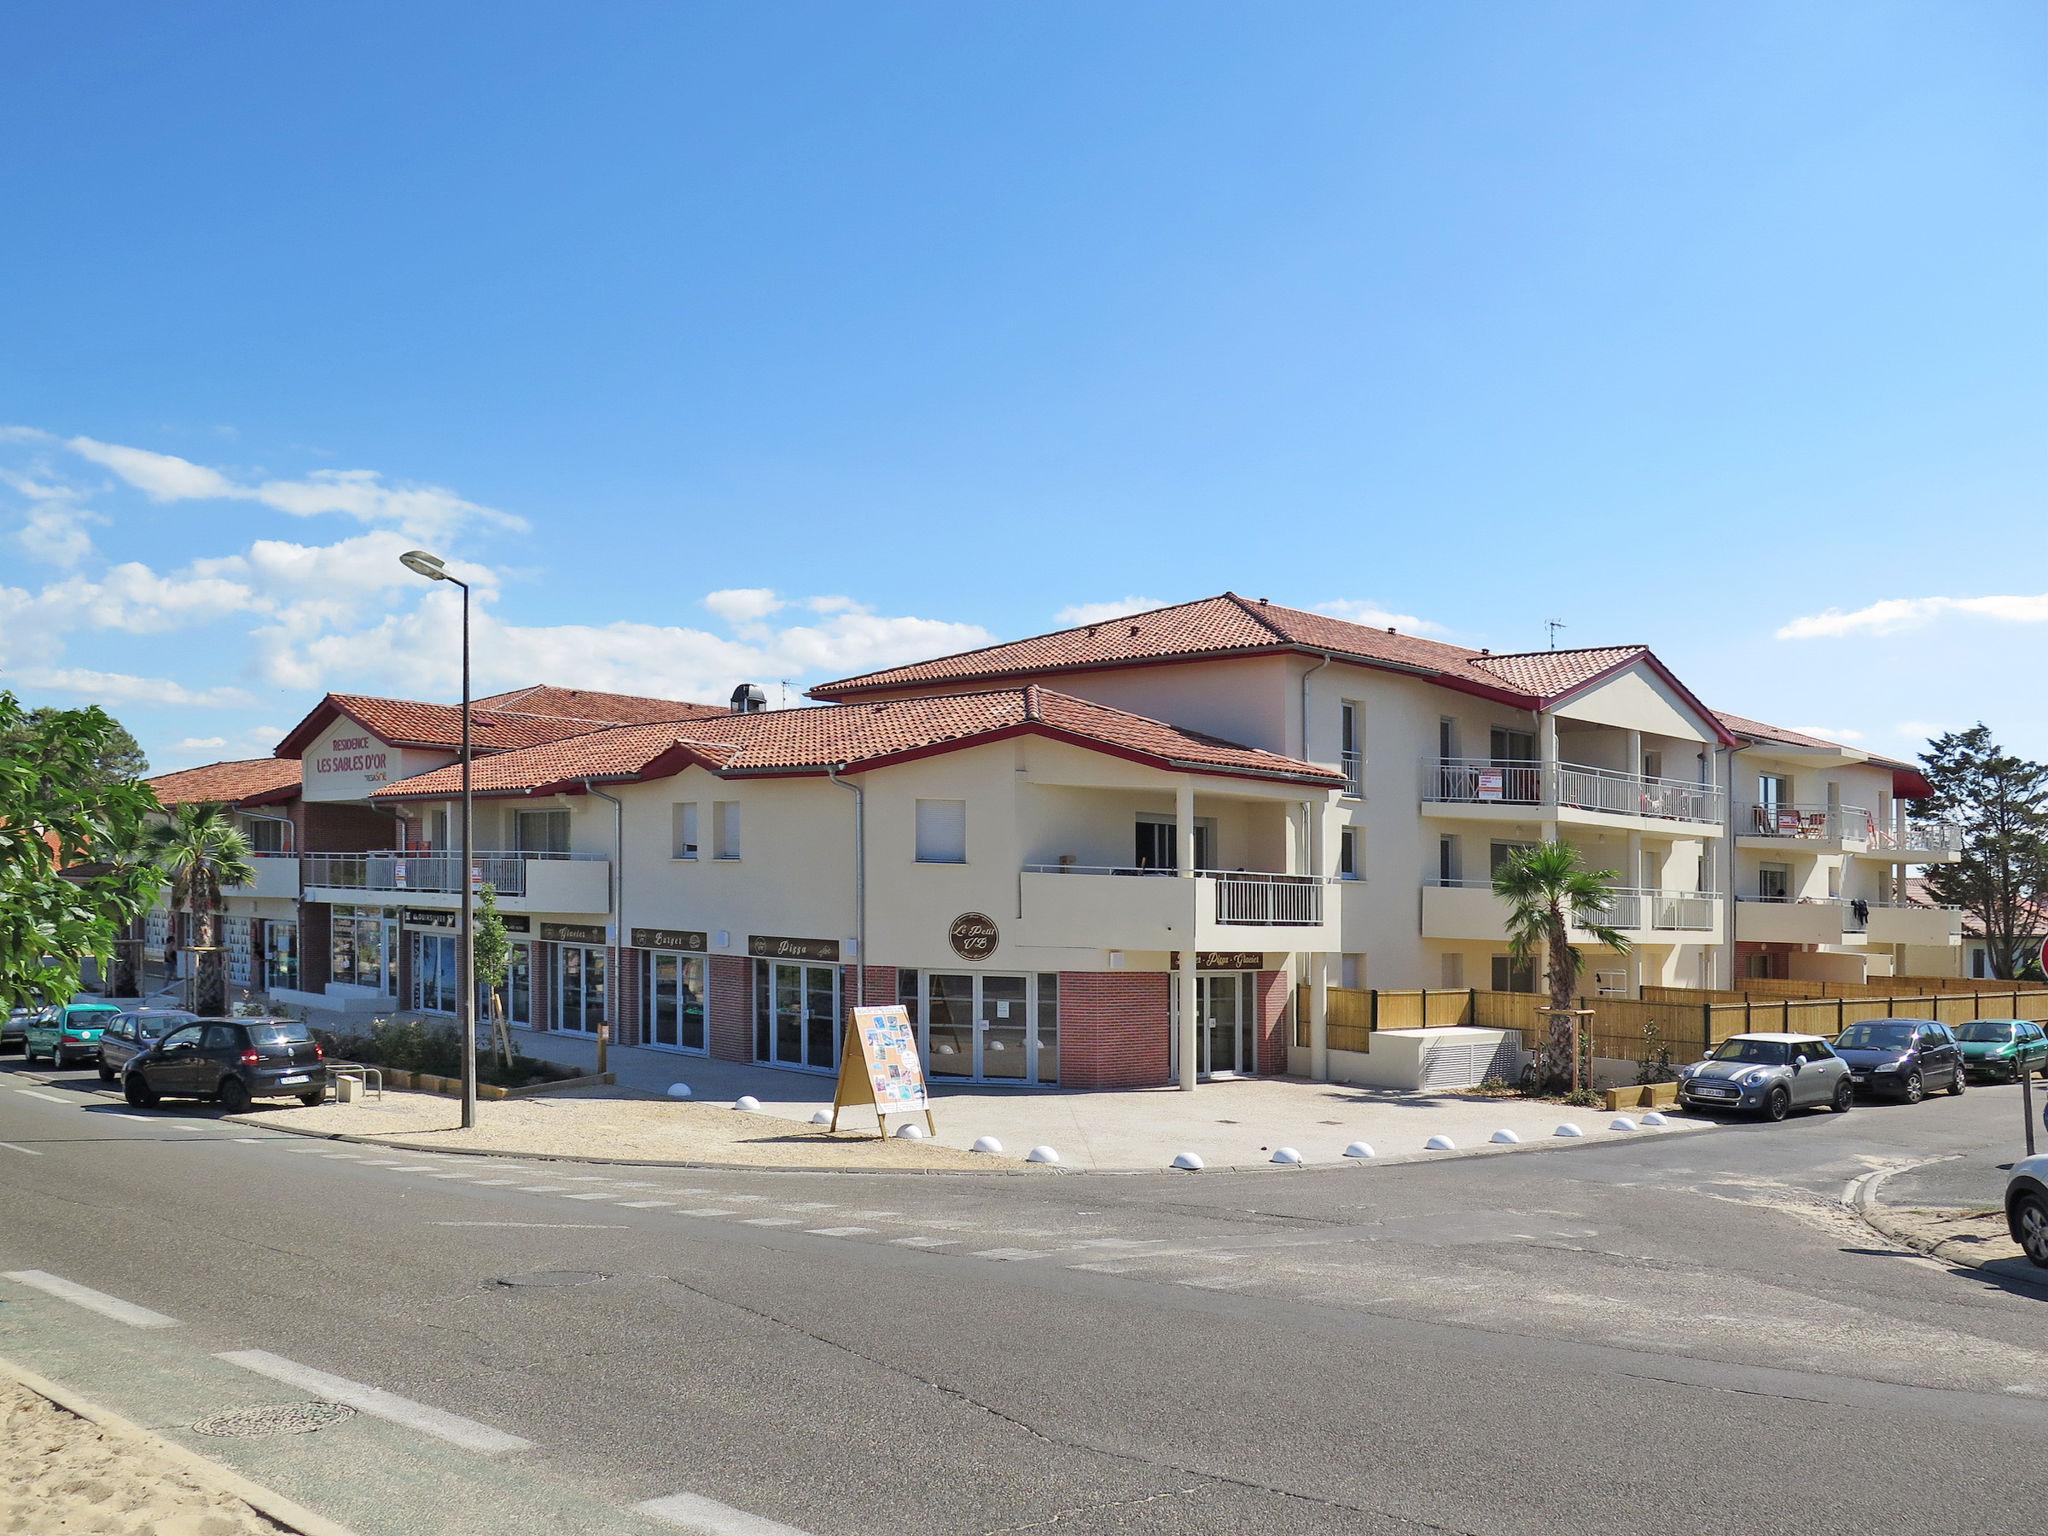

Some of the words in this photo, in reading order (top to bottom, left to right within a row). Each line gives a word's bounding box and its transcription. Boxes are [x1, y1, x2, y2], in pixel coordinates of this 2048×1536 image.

[333, 737, 369, 751] RESIDENCE
[317, 758, 332, 773] LES
[333, 755, 364, 772] SABLES
[365, 753, 387, 769] D'OR
[558, 926, 586, 940] Glacier
[952, 925, 967, 937] Le
[968, 925, 995, 937] Petit
[655, 932, 682, 946] Burger
[778, 940, 807, 955] Pizza
[1207, 952, 1229, 966] Pizza
[1233, 953, 1259, 968] Glacier
